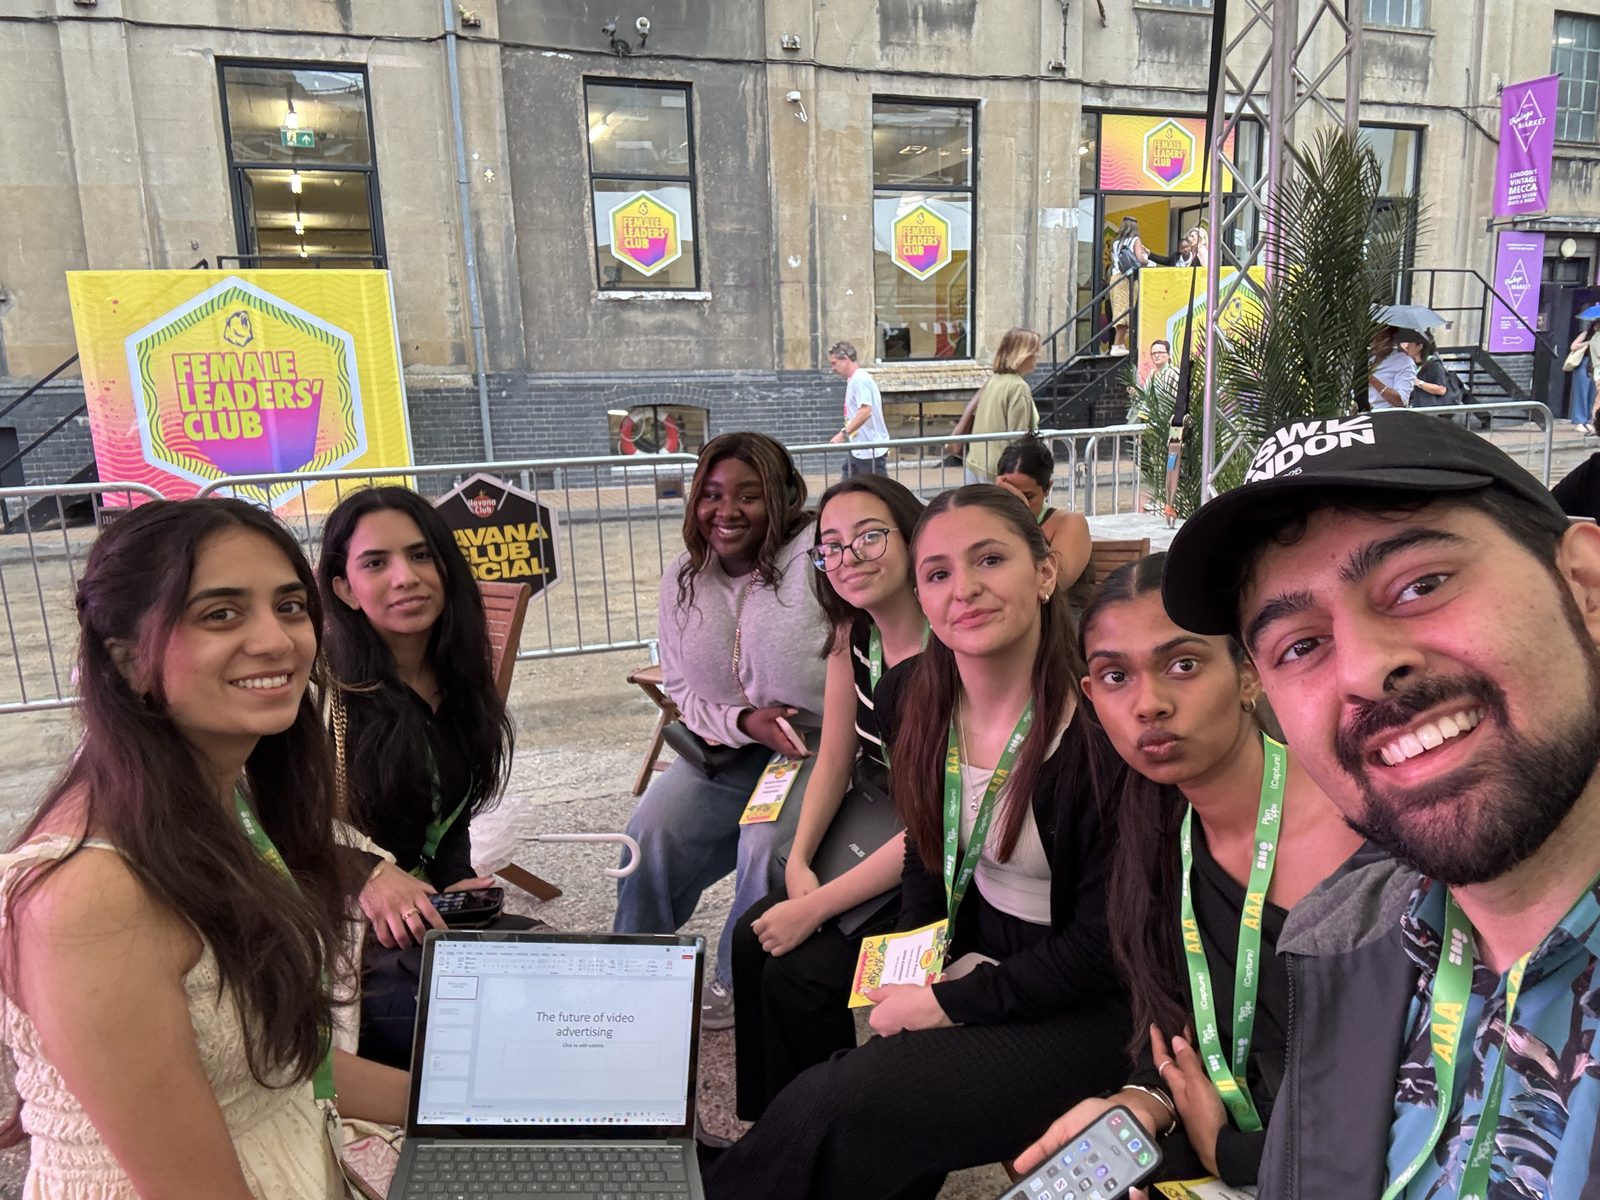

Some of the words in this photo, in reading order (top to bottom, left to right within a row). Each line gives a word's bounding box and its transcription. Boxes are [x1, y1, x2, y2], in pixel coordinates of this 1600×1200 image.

[1518, 118, 1546, 129] MARKET
[1153, 140, 1181, 149] FEMALE
[1153, 157, 1171, 167] CLUB
[1510, 176, 1537, 186] VINTAGE
[1509, 183, 1537, 195] MECCA
[623, 216, 661, 228] FEMALE
[903, 226, 935, 236] FEMALE
[624, 238, 650, 249] CLUB
[903, 245, 925, 256] CLUB
[172, 351, 297, 383] FEMALE
[178, 379, 323, 413] LEADERS'
[183, 410, 263, 442] CLUB
[946, 746, 960, 775] AAA
[1243, 892, 1265, 931] AAA
[1183, 919, 1202, 954] AAA
[1243, 949, 1255, 987] (Capture)
[1196, 971, 1209, 1010] (Capture)
[536, 1011, 556, 1022] The
[558, 1011, 591, 1023] future
[592, 1012, 605, 1023] of
[606, 1012, 635, 1023] video
[555, 1026, 613, 1039] advertising
[1432, 1002, 1462, 1066] AAA
